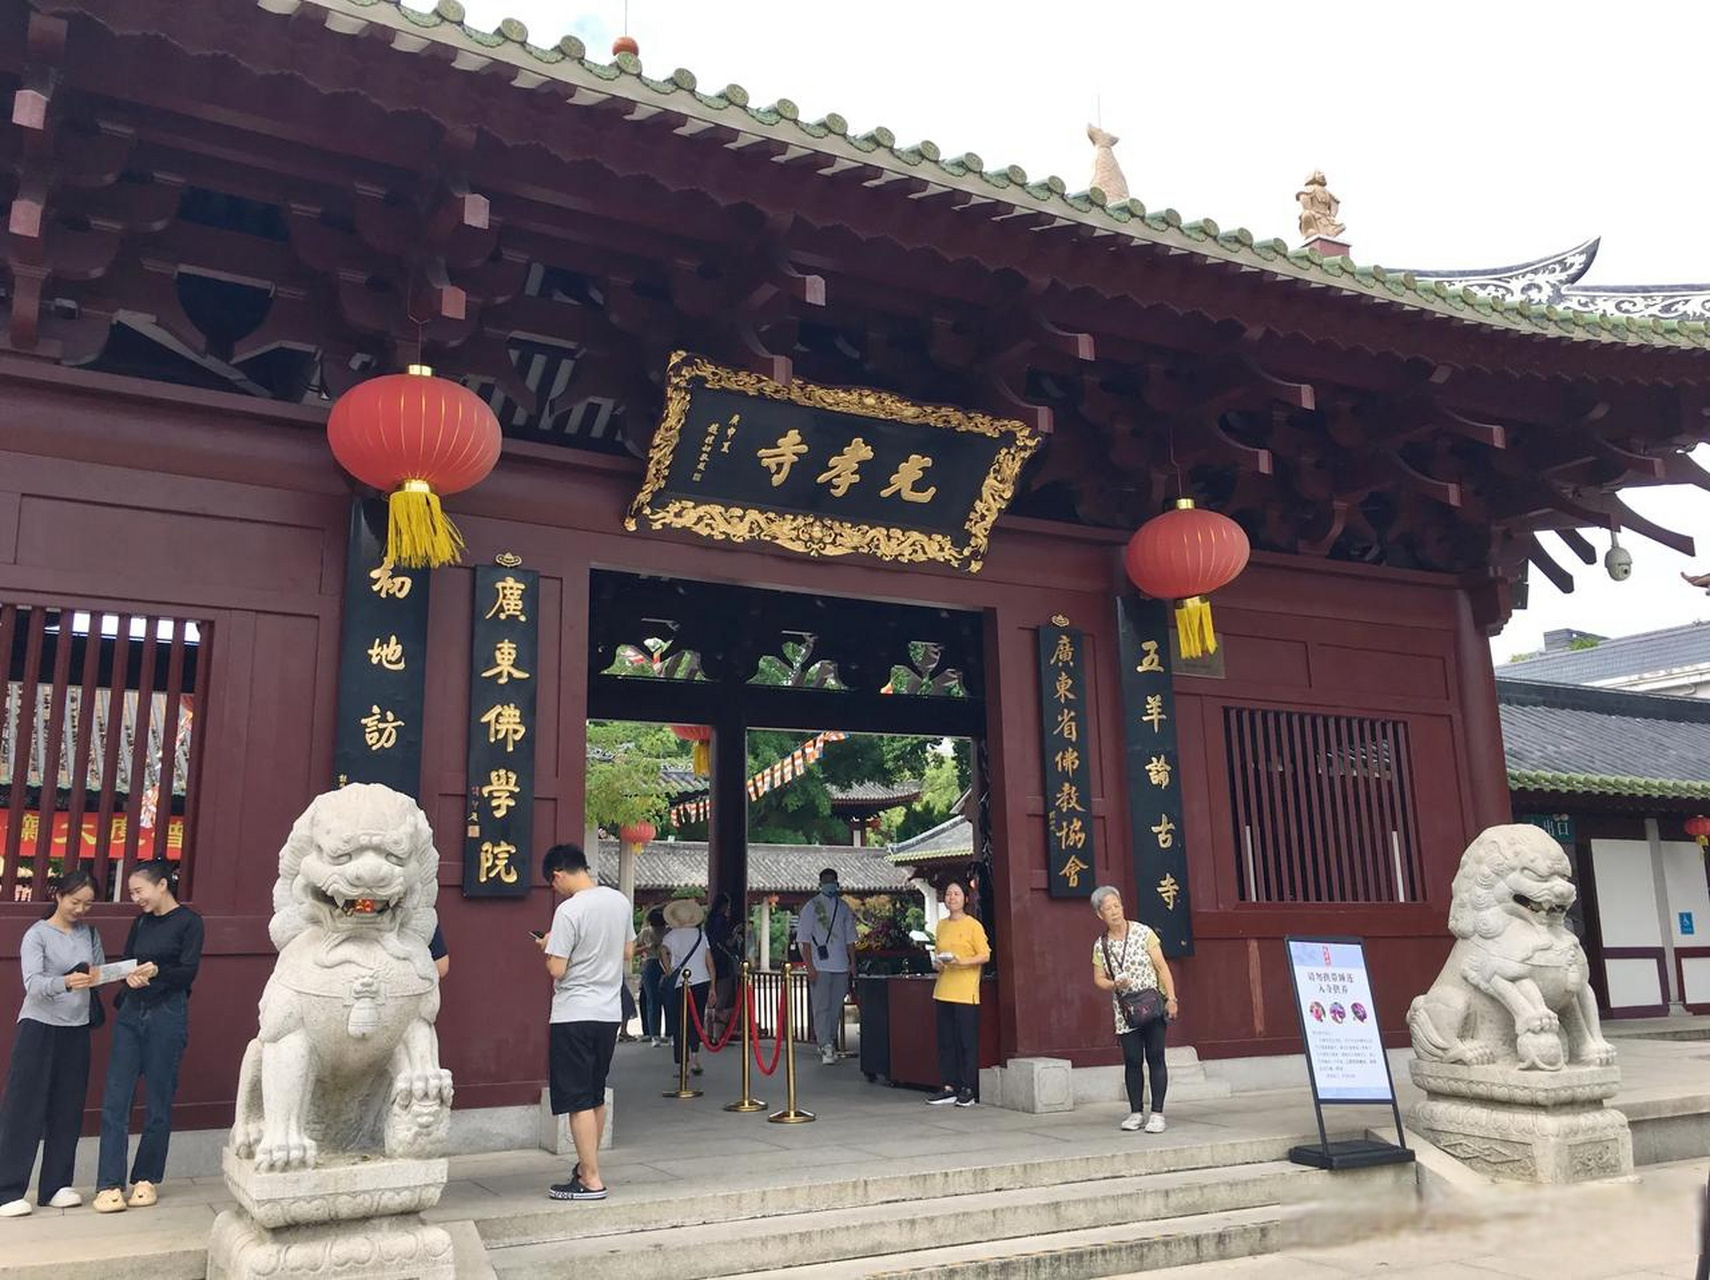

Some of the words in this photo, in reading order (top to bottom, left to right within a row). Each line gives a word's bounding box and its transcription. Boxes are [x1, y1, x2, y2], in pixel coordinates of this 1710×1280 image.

[478, 575, 530, 885] 廣東佛學院
[1049, 635, 1089, 888] 廣東省佛教協會
[1136, 640, 1181, 911] 五羊論古寺
